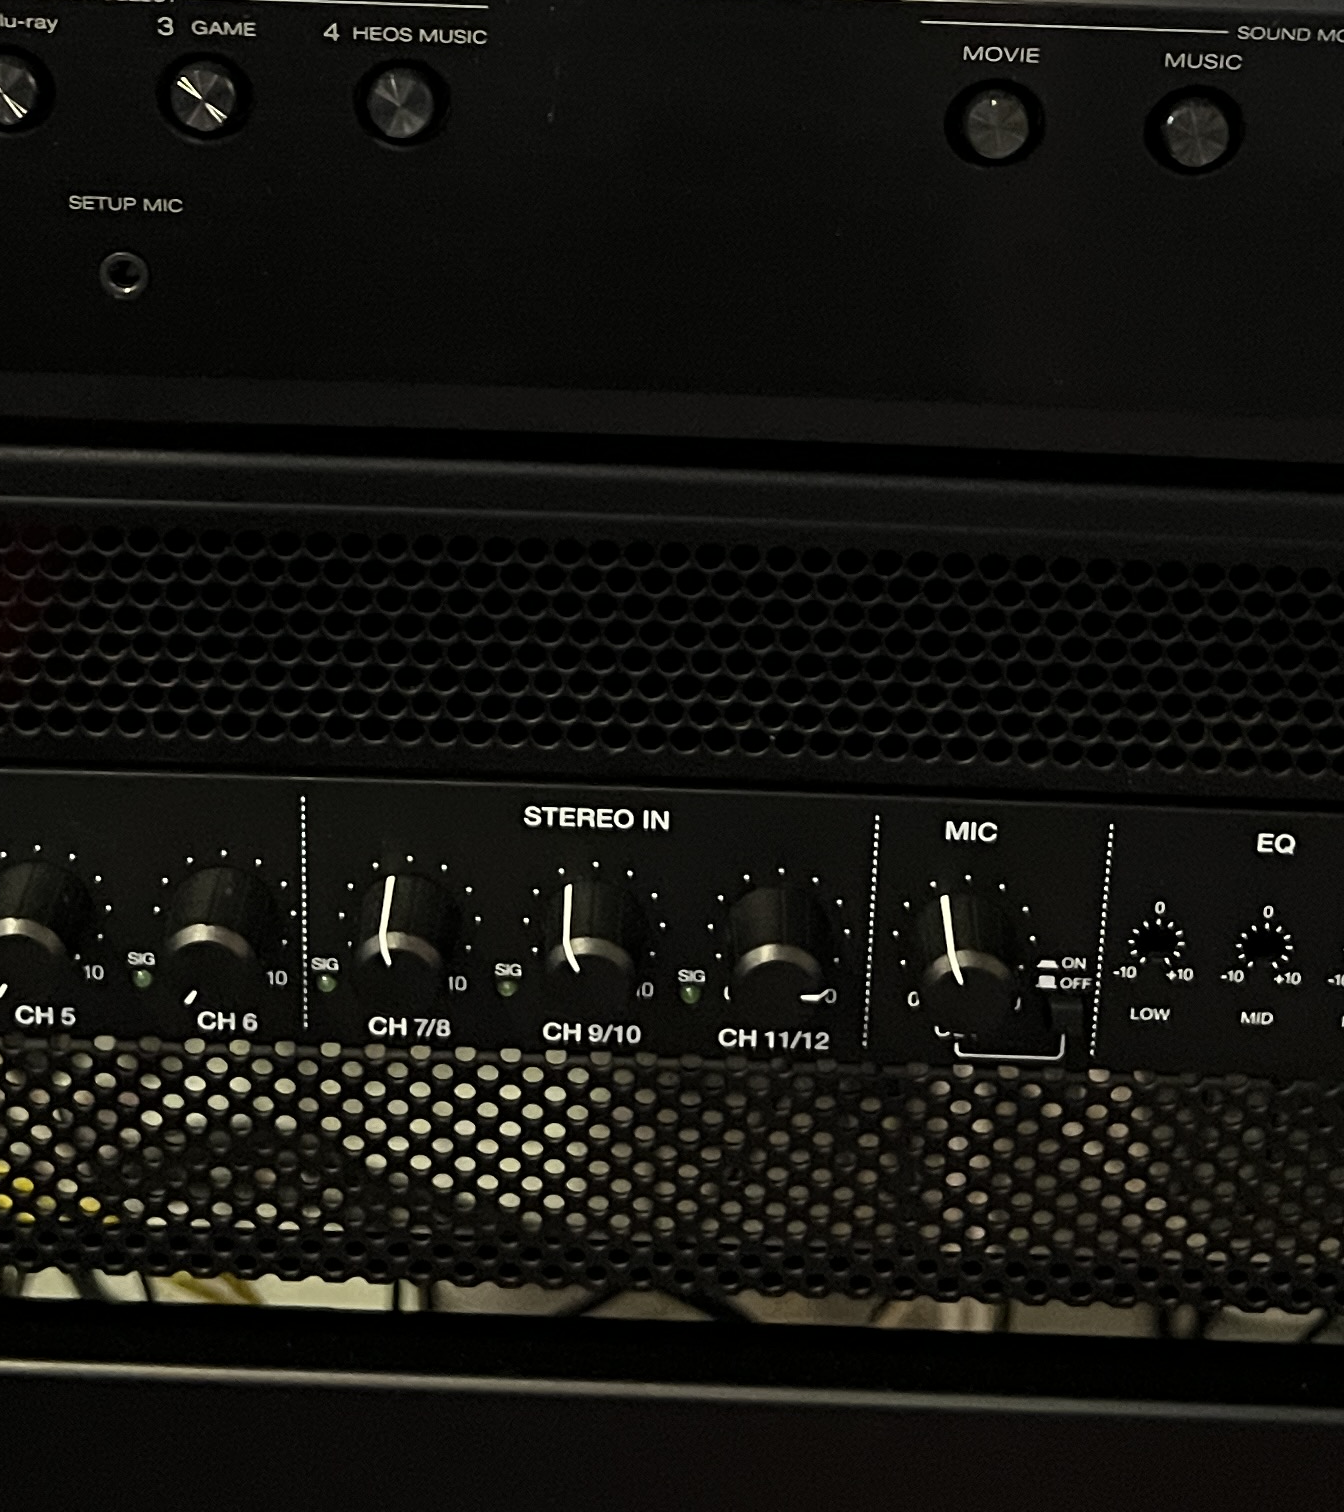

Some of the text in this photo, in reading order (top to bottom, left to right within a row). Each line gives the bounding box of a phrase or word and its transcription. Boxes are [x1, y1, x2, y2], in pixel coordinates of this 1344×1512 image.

[158, 17, 256, 37] 3 GAME
[324, 22, 488, 46] 4 HEOS MUSIC
[1237, 26, 1311, 43] SOUND
[963, 46, 1041, 64] MOVIE
[1164, 53, 1243, 71] MUSIC
[69, 195, 183, 214] SETUP MIC
[524, 806, 670, 830] STEREO IN
[945, 821, 998, 843] MIC
[1257, 833, 1296, 856] EQ
[1155, 901, 1165, 915] 0
[311, 957, 339, 972] SIG
[1113, 965, 1137, 979] -10
[267, 968, 288, 986] 10
[678, 969, 706, 984] SIG
[1166, 967, 1194, 981] +10
[197, 1010, 257, 1033] CH 6
[1130, 1007, 1171, 1022] LOW
[1241, 1011, 1273, 1026] MID
[368, 1016, 451, 1039] CH 7/8
[542, 1022, 641, 1045] CH 9/10
[718, 1028, 830, 1051] CH 11/12
